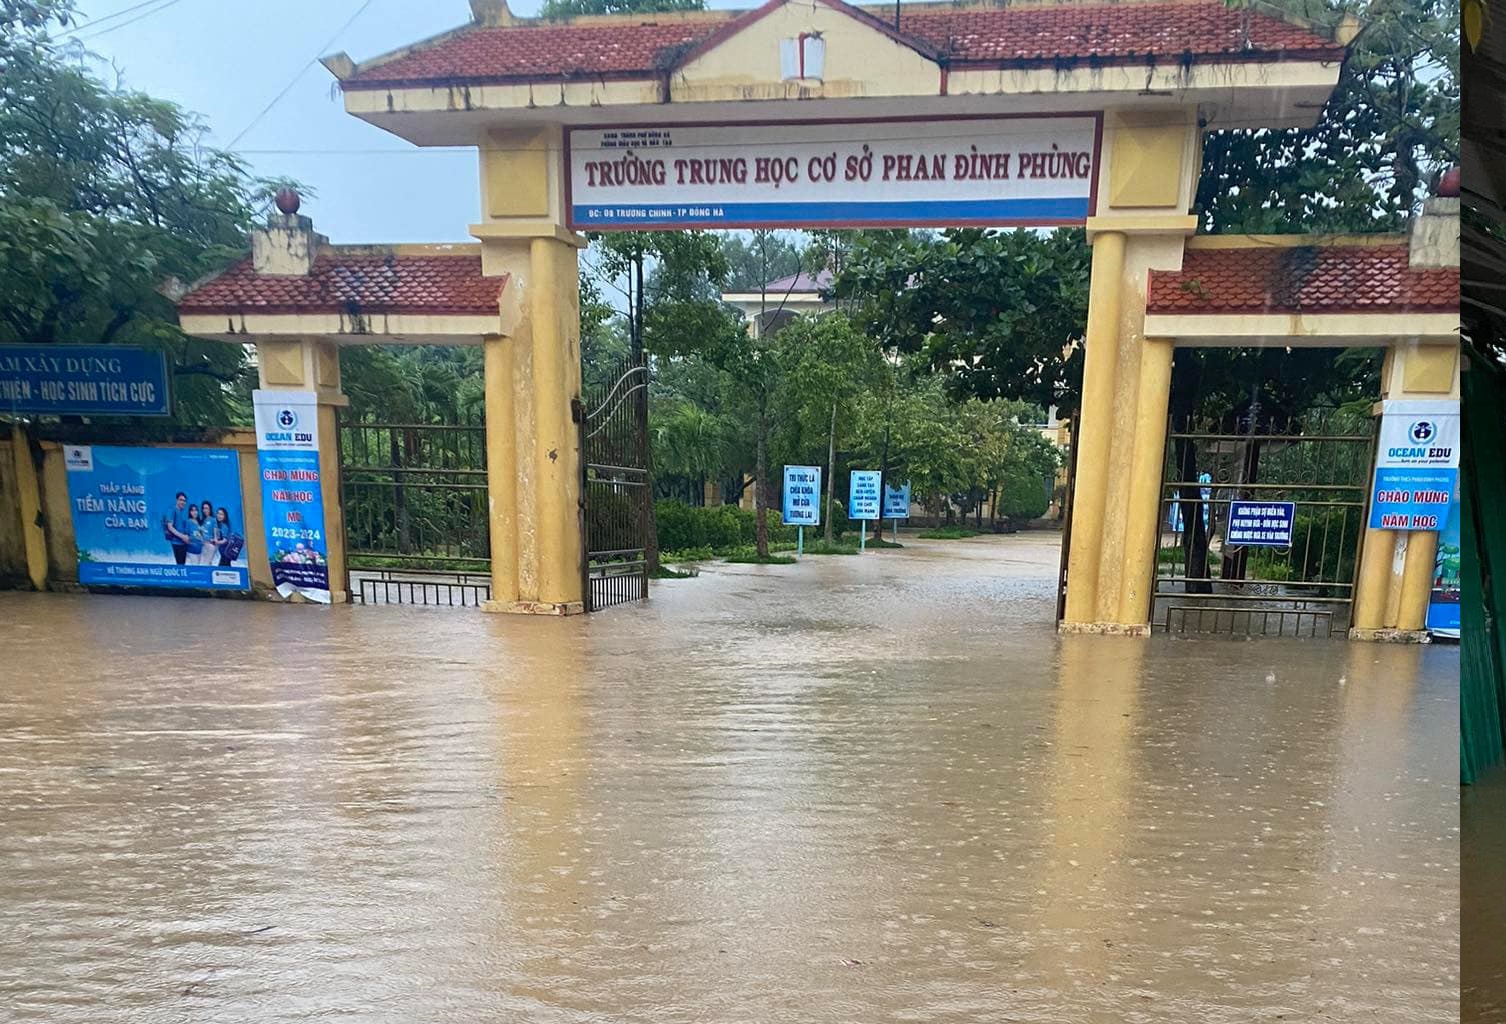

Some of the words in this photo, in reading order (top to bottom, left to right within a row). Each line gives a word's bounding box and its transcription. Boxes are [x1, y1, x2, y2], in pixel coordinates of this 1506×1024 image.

[585, 150, 666, 187] TRƯỜNG
[674, 157, 747, 185] TRUNG
[755, 157, 799, 189] HỌC
[807, 152, 837, 183] CƠ
[844, 144, 873, 182] SỞ
[882, 154, 947, 181] PHAN
[953, 144, 1011, 181] ĐÌNH
[1017, 143, 1091, 180] PHÙNG
[24, 353, 61, 374] XÂY
[66, 356, 122, 377] DỰNG
[0, 377, 31, 404] HIỆN
[40, 380, 65, 405] HỌC
[67, 380, 98, 401] SINH
[99, 377, 127, 401] TÍCH
[130, 380, 156, 407] CỰC
[294, 432, 313, 442] EDU
[1388, 447, 1426, 458] OCEAN
[1428, 447, 1452, 458] EDU
[107, 497, 147, 514] NĂNG
[105, 513, 126, 528] CỦA
